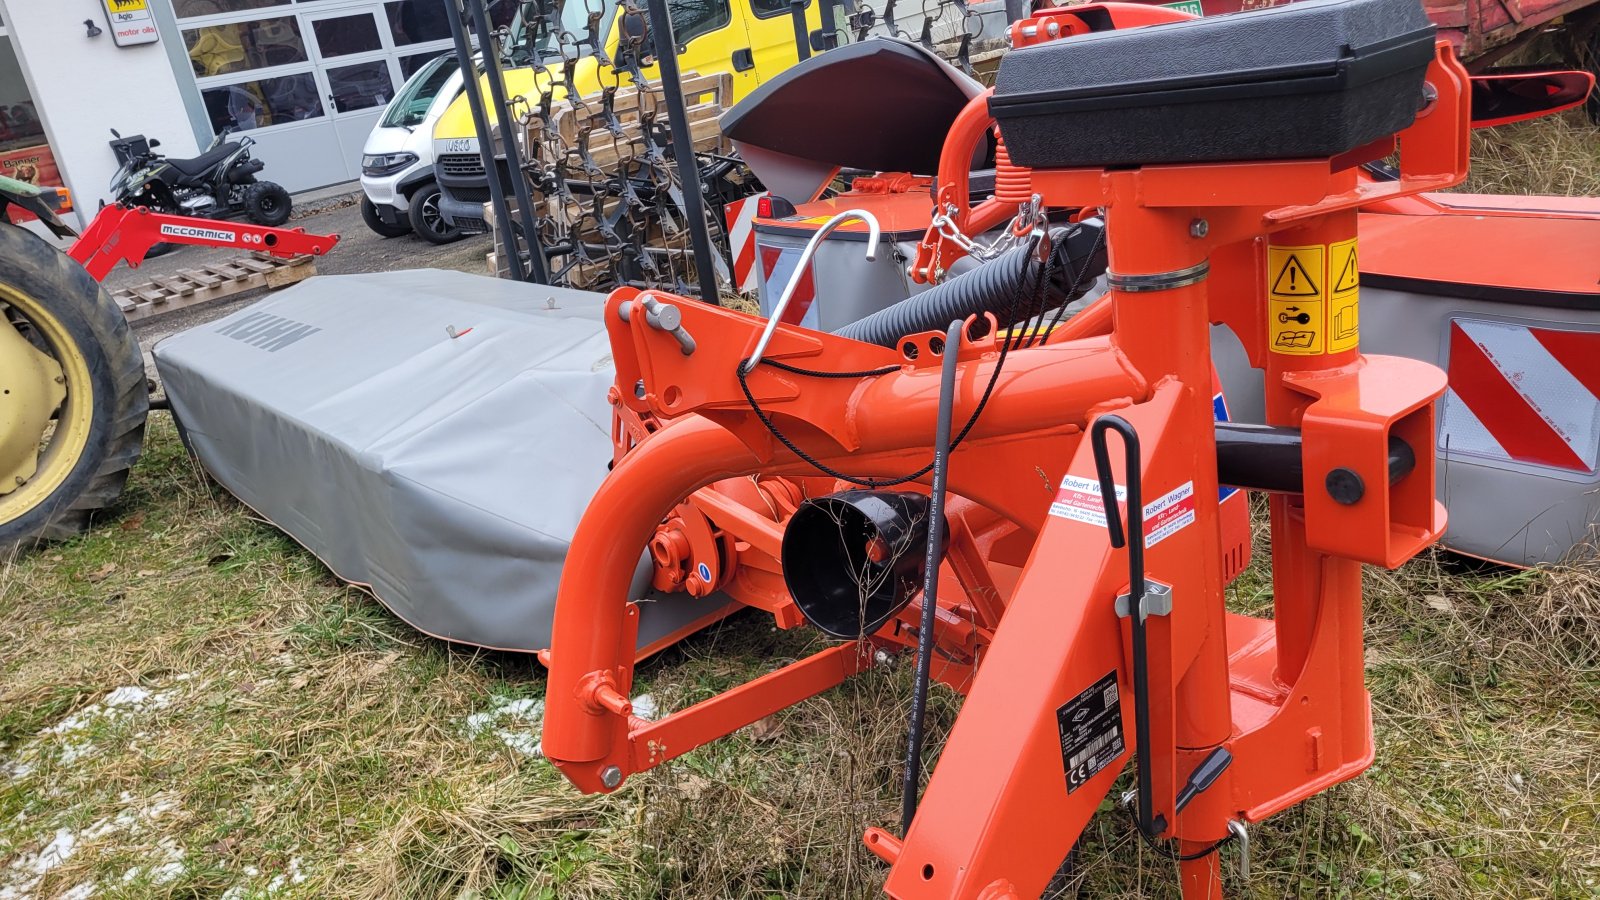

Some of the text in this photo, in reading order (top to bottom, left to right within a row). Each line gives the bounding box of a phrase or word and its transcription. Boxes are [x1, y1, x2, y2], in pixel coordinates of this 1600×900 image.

[117, 26, 155, 37] motor oils
[445, 139, 470, 152] IVECO
[3, 157, 40, 168] Banner
[213, 311, 324, 353] KUHN
[1063, 478, 1124, 497] Robert Wer
[1061, 497, 1074, 505] und
[1145, 486, 1191, 517] Robert Wagner
[1160, 507, 1187, 527] Gartentechnik
